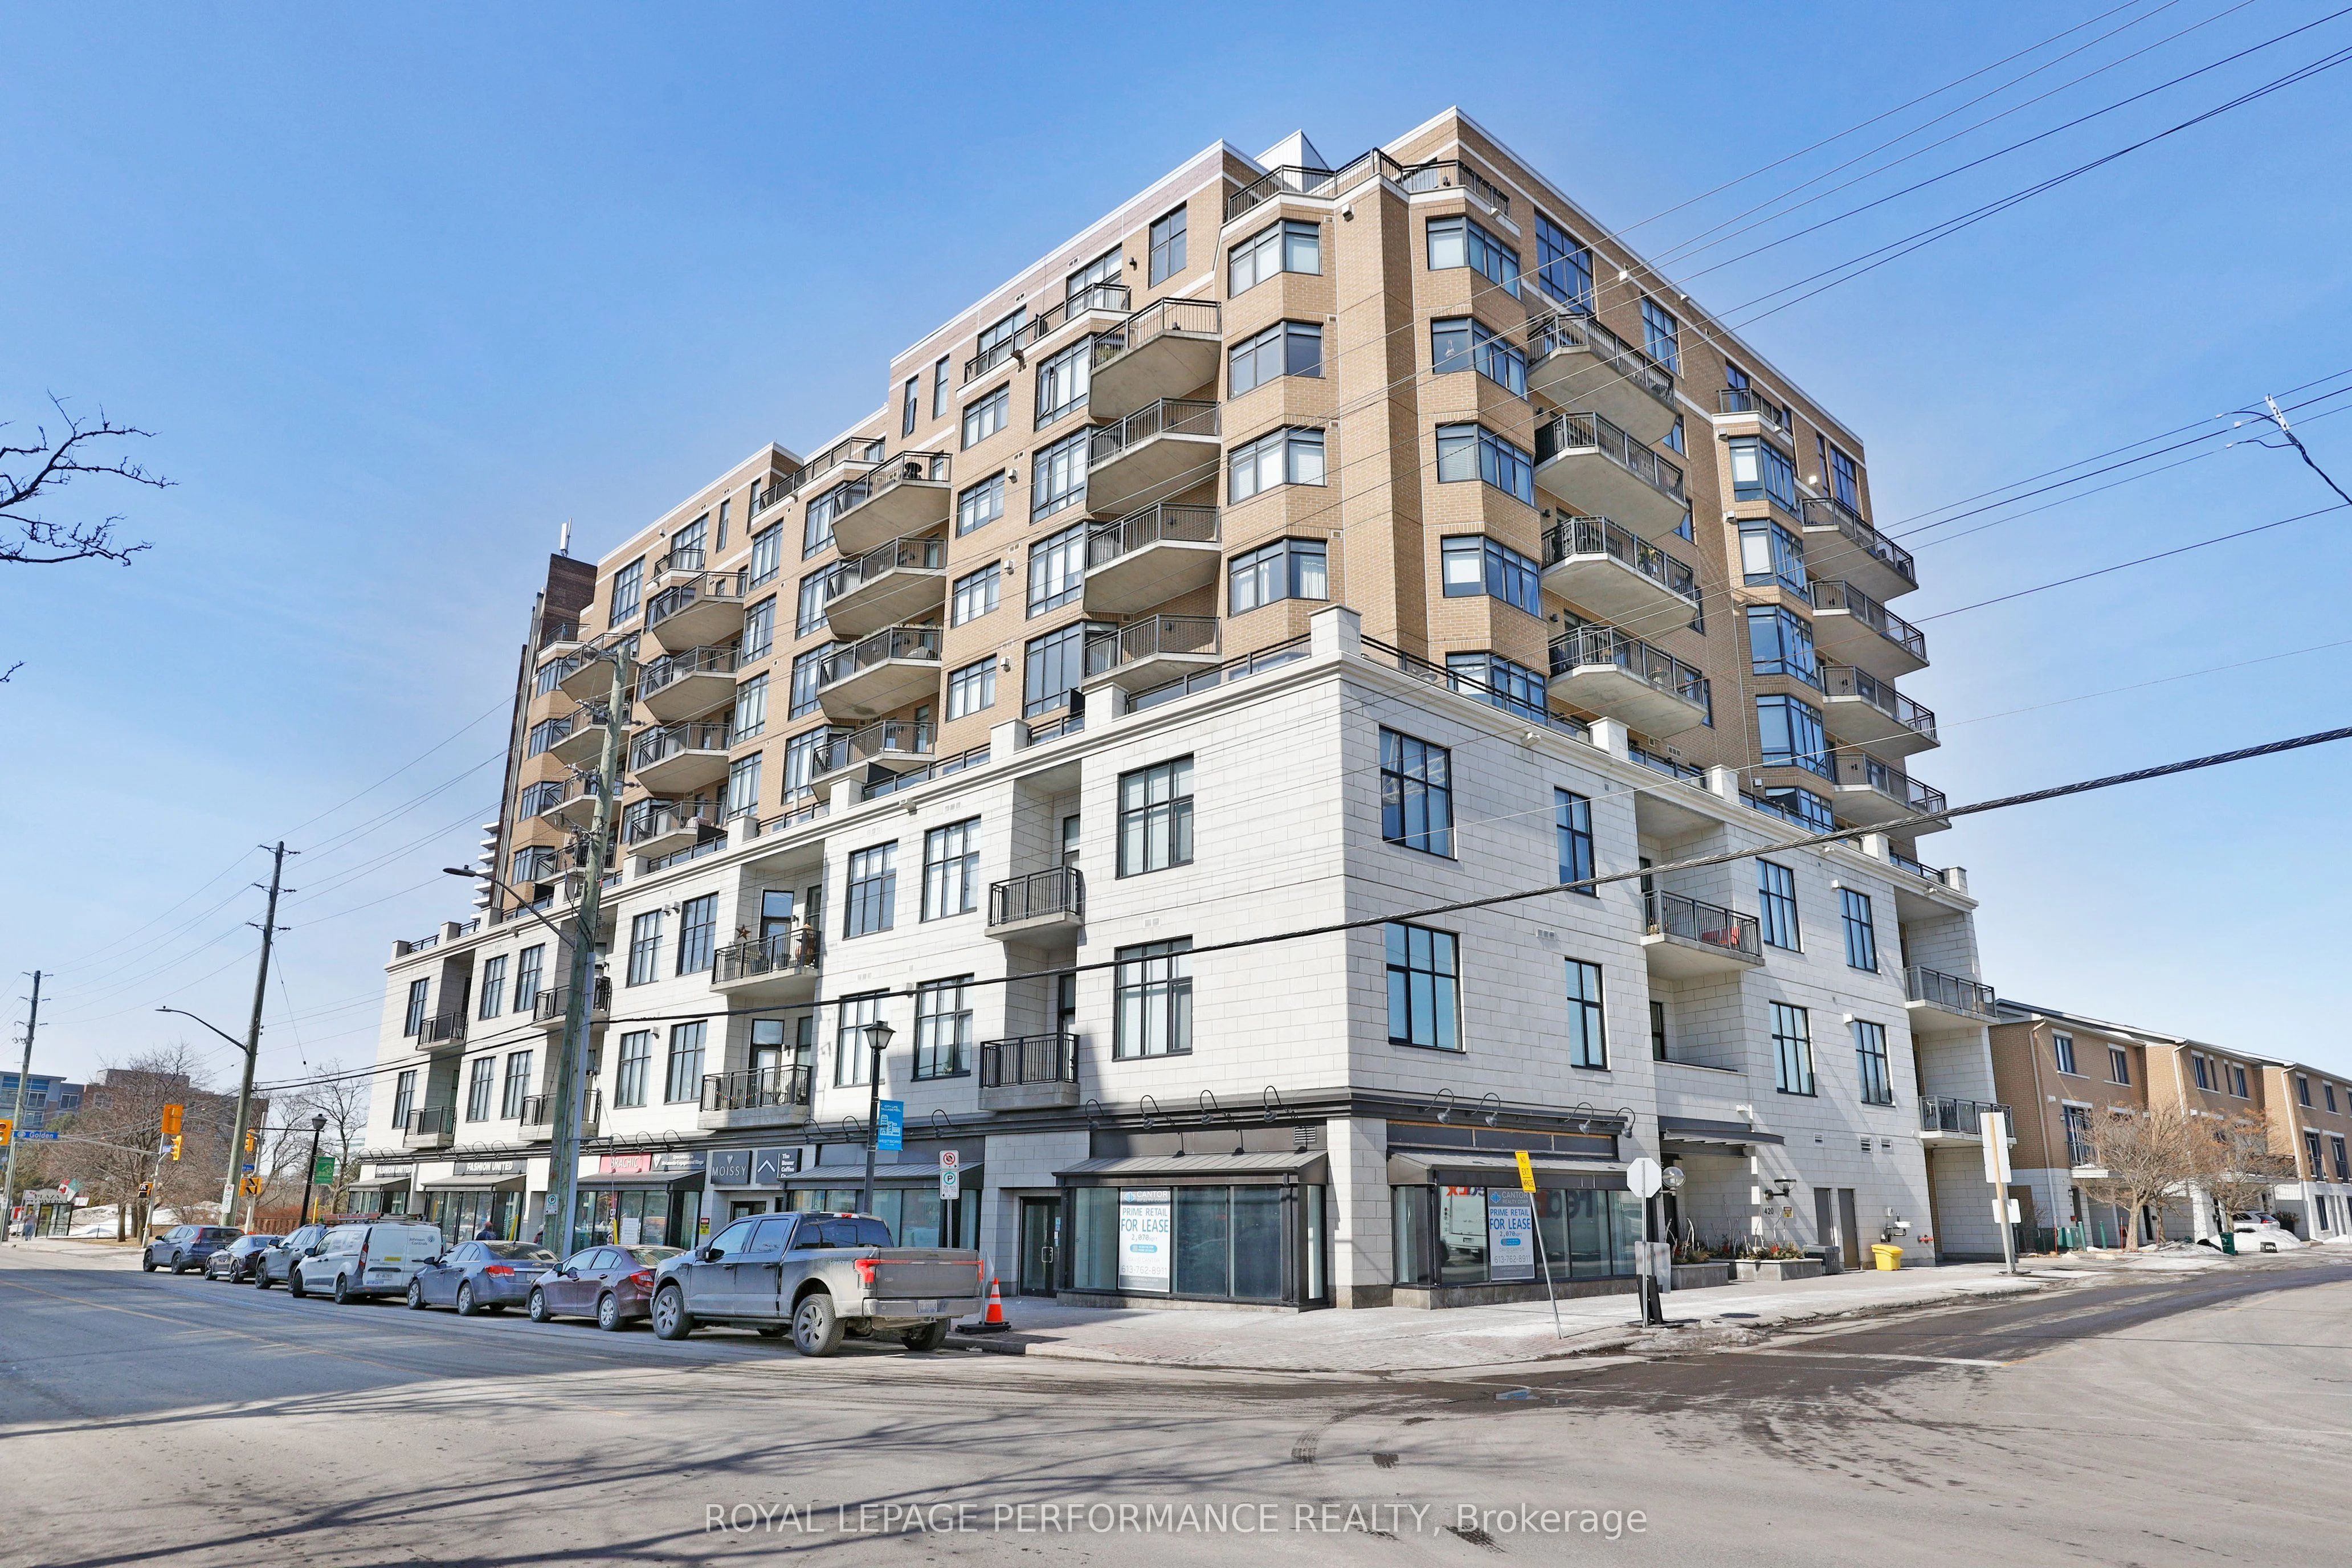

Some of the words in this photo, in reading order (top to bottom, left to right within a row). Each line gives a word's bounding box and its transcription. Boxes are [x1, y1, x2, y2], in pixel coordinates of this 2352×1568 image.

[466, 1162, 491, 1171] FASHION
[492, 1161, 513, 1171] UNITED
[610, 1157, 639, 1168] BRACHIC
[376, 1165, 395, 1174] FASHION
[395, 1164, 412, 1174] UNITED
[712, 1166, 747, 1177] MOISSY
[1146, 1208, 1167, 1216] RETAIL
[1121, 1219, 1138, 1231] FOR
[1142, 1219, 1169, 1232] LEASE
[1490, 1218, 1505, 1230] FOR
[1508, 1218, 1531, 1230] LEASE
[1494, 1255, 1531, 1263] 613-762-8911
[1121, 1265, 1167, 1275] 613-762-8911
